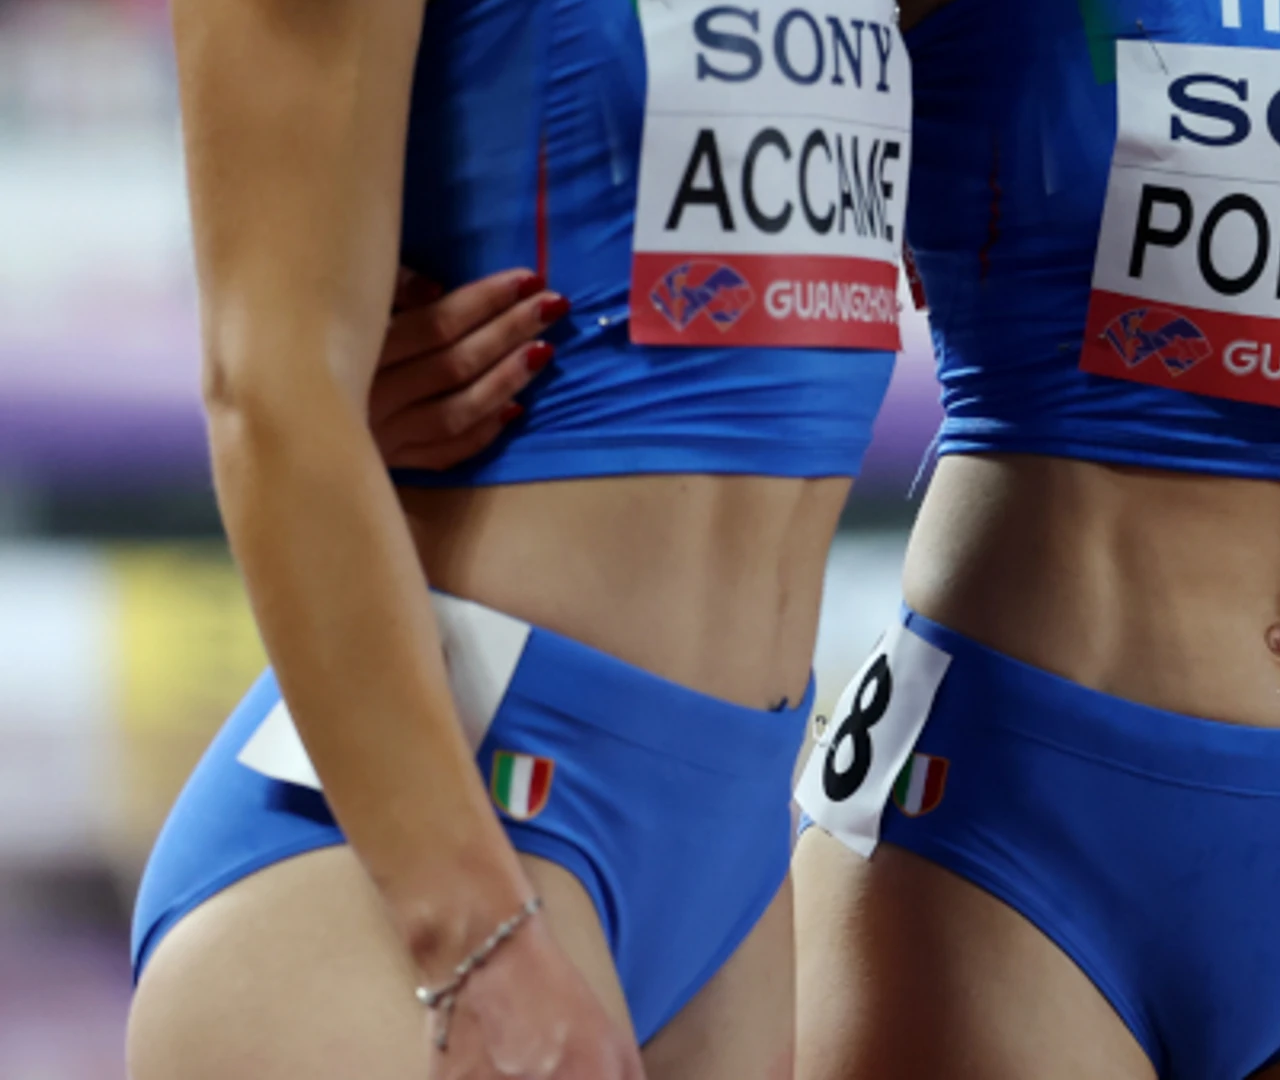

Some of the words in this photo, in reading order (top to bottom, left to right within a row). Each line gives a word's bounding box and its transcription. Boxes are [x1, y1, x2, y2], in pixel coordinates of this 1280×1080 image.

[693, 5, 892, 93] SONY
[663, 126, 900, 243] ACCAME
[822, 652, 893, 803] 8
